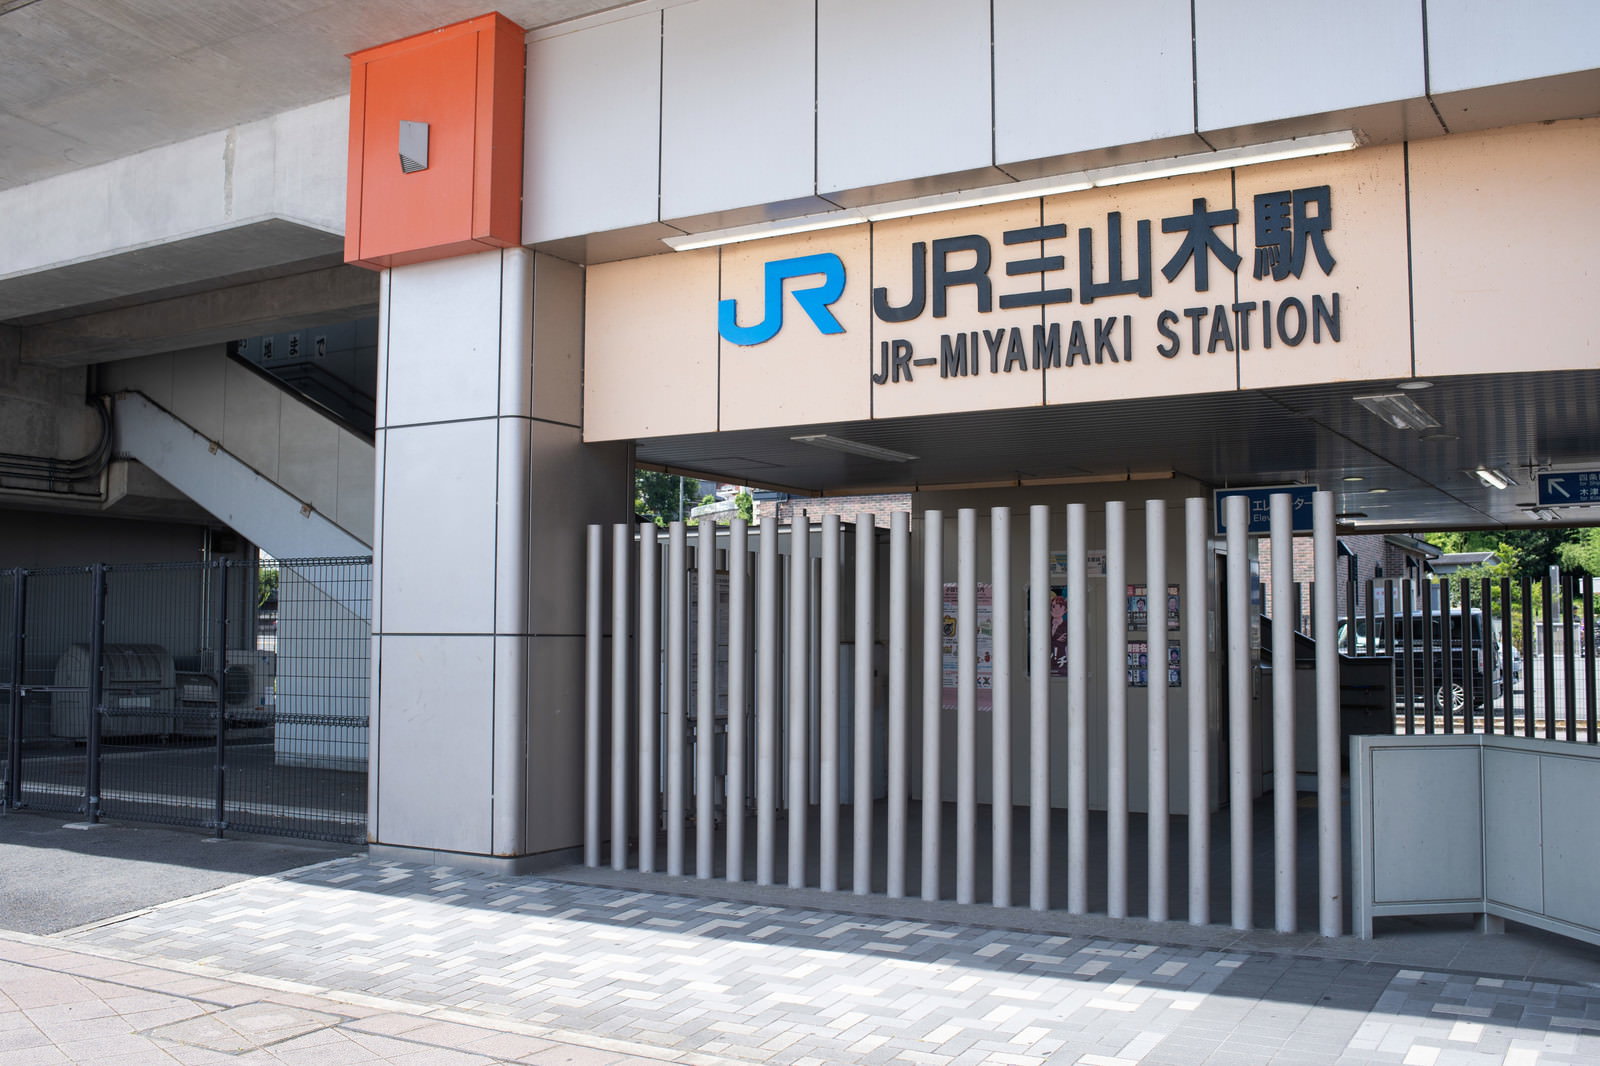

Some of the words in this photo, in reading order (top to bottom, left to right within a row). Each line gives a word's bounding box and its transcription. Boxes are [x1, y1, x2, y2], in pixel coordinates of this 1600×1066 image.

[718, 252, 847, 346] JR
[873, 185, 1337, 323] JR三山木駅
[872, 315, 1131, 385] JR-MIYAMAKI
[1157, 292, 1340, 358] STATION
[1253, 496, 1312, 511] エレター
